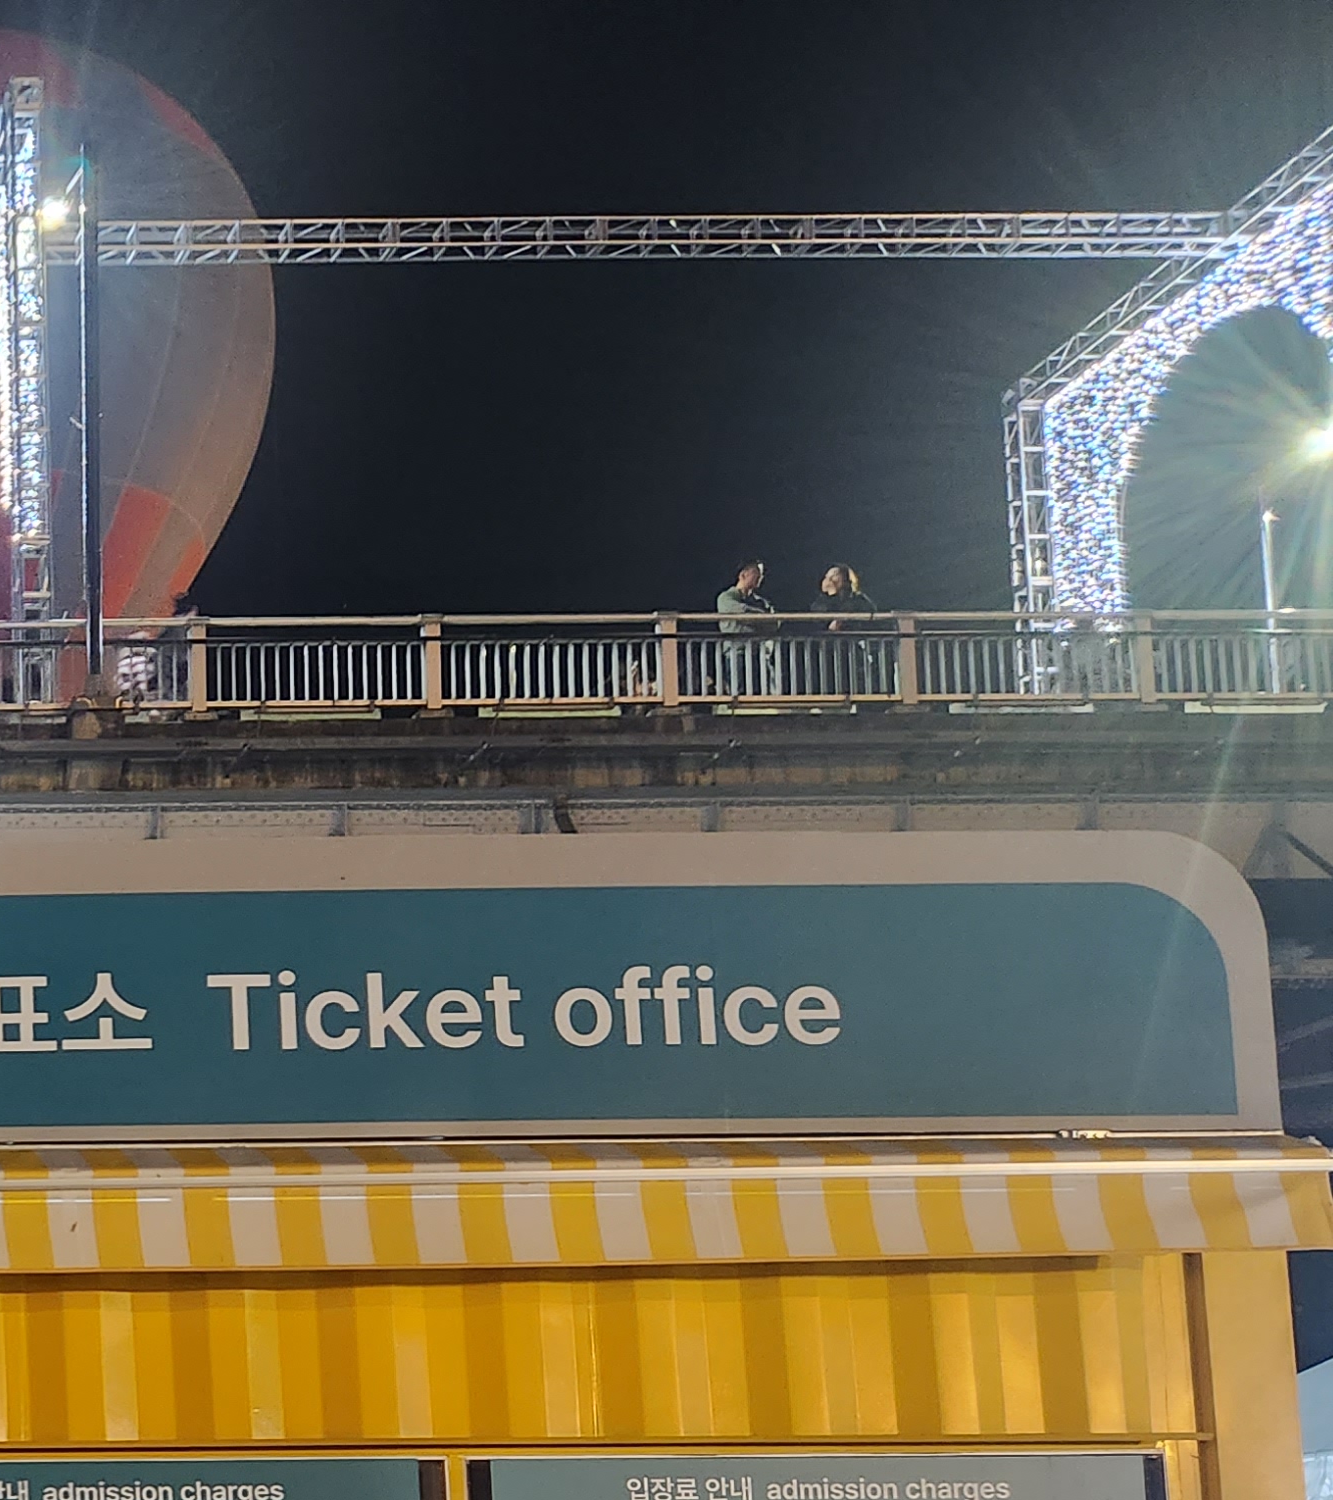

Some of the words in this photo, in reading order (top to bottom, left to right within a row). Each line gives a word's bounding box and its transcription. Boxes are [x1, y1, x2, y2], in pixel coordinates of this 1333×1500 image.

[207, 969, 524, 1050] Ticket
[554, 965, 841, 1047] office
[766, 1476, 898, 1500] admission
